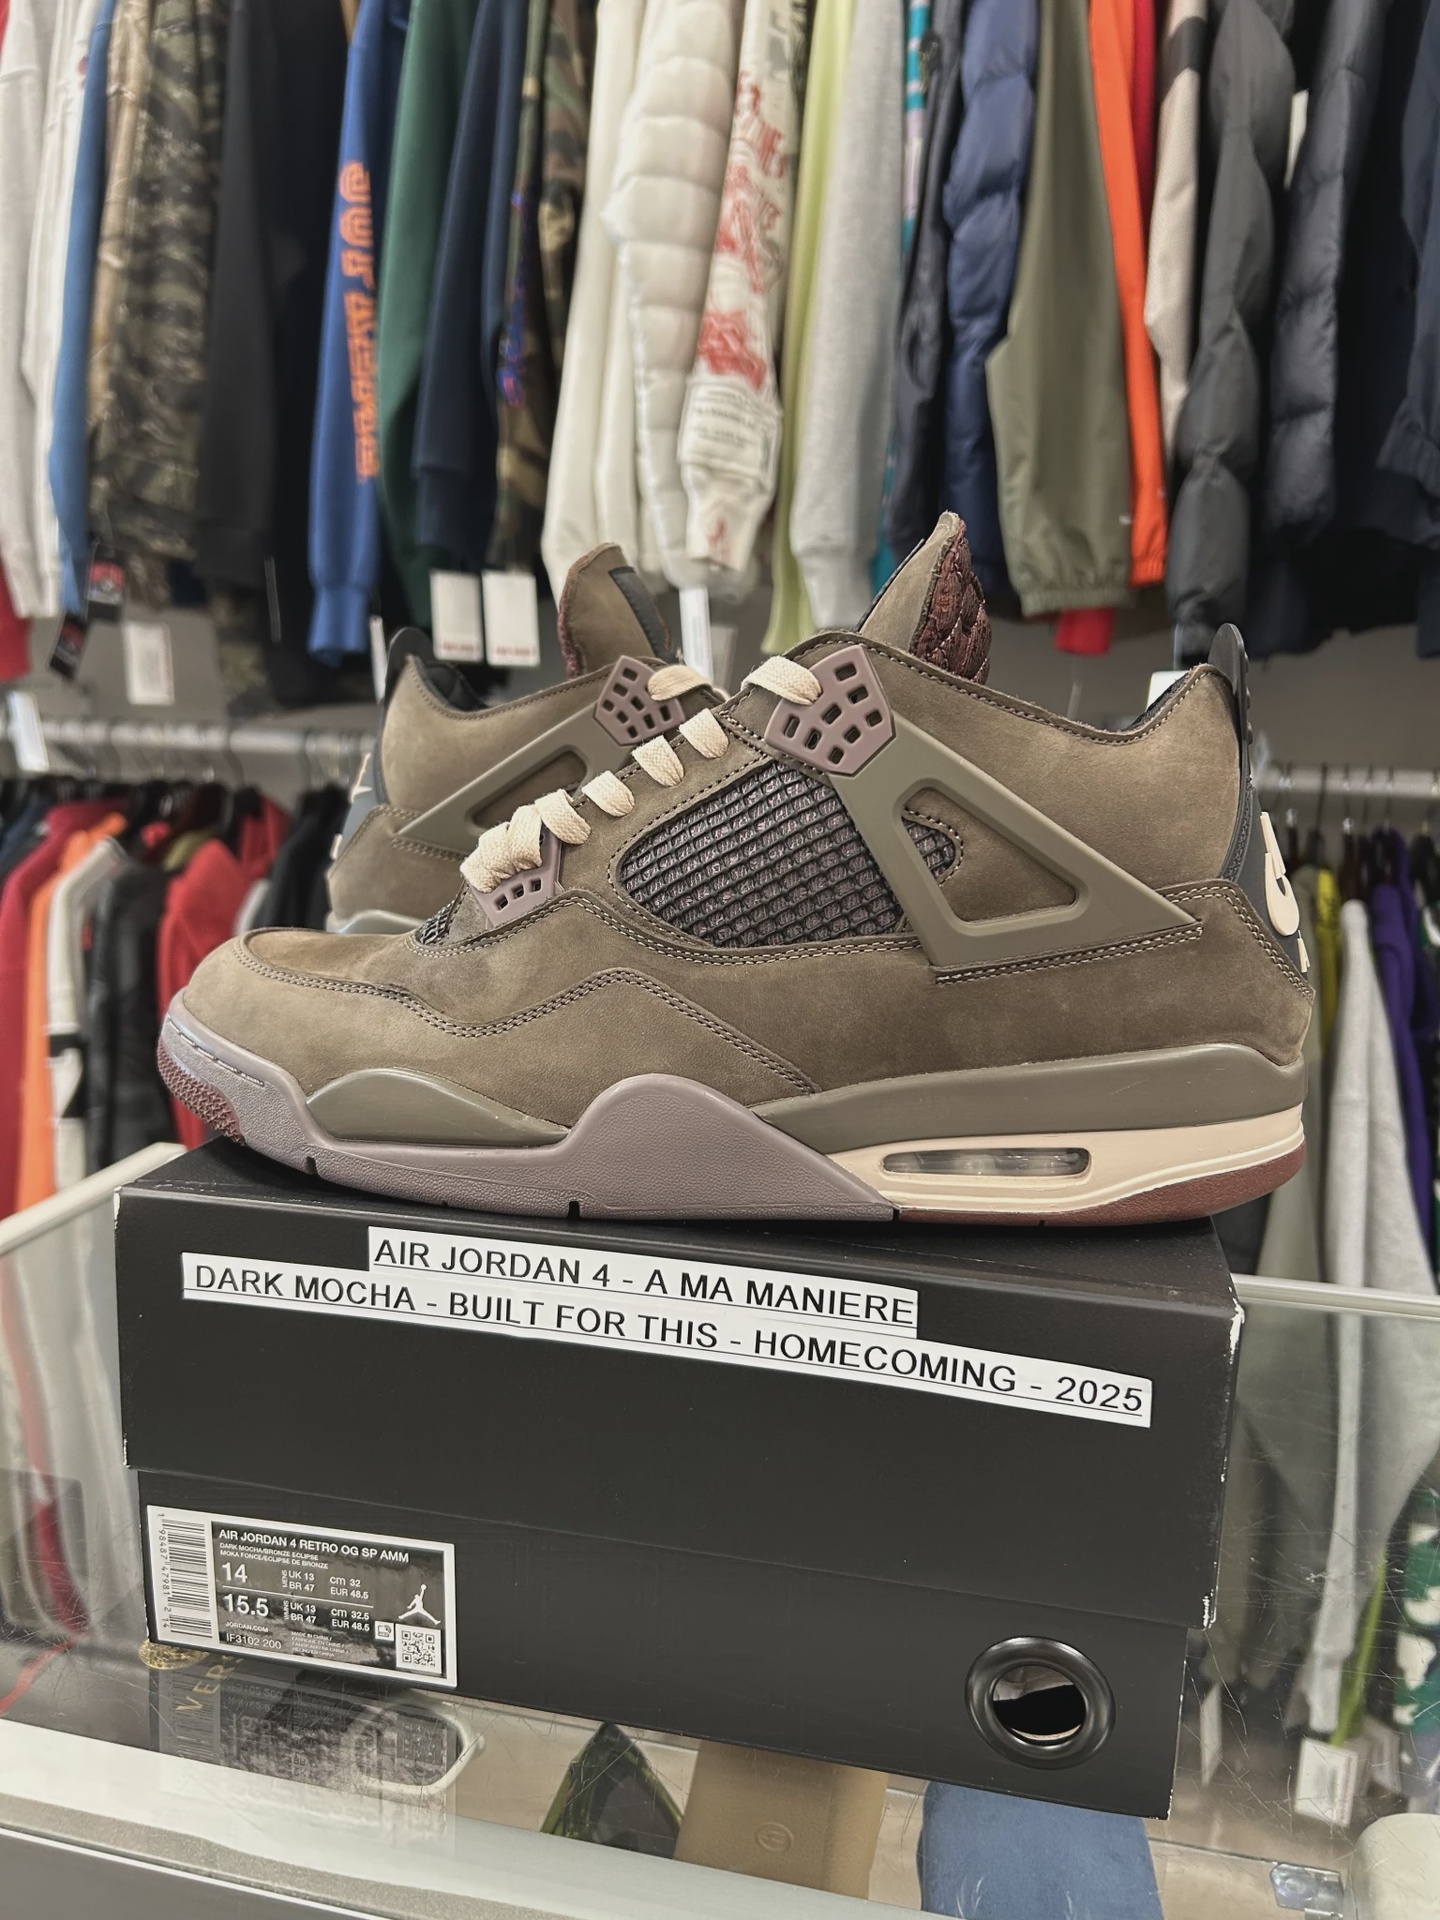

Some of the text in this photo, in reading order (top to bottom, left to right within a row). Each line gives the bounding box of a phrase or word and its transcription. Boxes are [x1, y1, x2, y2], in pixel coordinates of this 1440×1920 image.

[374, 1239, 430, 1267] AIR
[441, 1246, 580, 1284] JORDAN
[592, 1264, 610, 1287] 4
[644, 1269, 669, 1294] A
[680, 1272, 733, 1302] MA
[746, 1280, 914, 1325] MANIERE
[196, 1265, 284, 1296] DARK
[295, 1275, 416, 1311] MOCHA
[449, 1291, 545, 1326] BUILT
[556, 1304, 625, 1337] FOR
[638, 1314, 718, 1348] THIS
[754, 1329, 1016, 1392] HOMECOMING
[1055, 1376, 1143, 1411] 2025
[159, 1529, 168, 1560] 98487
[219, 1529, 409, 1562] AIR JORDAN 4 RETRO OG SP AMM
[220, 1542, 319, 1561] DARK MOCHA/BRONZE ECLIPSE
[220, 1549, 239, 1557] MOKA
[302, 1561, 328, 1569] BRONZE
[161, 1566, 170, 1596] 47981
[222, 1562, 248, 1583] 14
[288, 1570, 315, 1581] UK 13
[289, 1581, 315, 1592] BR 47
[330, 1576, 361, 1587] cm 32
[330, 1586, 369, 1599] EUR 48.5
[223, 1593, 269, 1617] 15.5
[290, 1602, 316, 1613] UK 13
[290, 1613, 316, 1624] BR 47
[331, 1608, 370, 1620] cm 32.5
[225, 1621, 269, 1633] JORDAN.COM
[332, 1619, 370, 1632] EUR 48.5
[226, 1632, 282, 1649] IF3102 200
